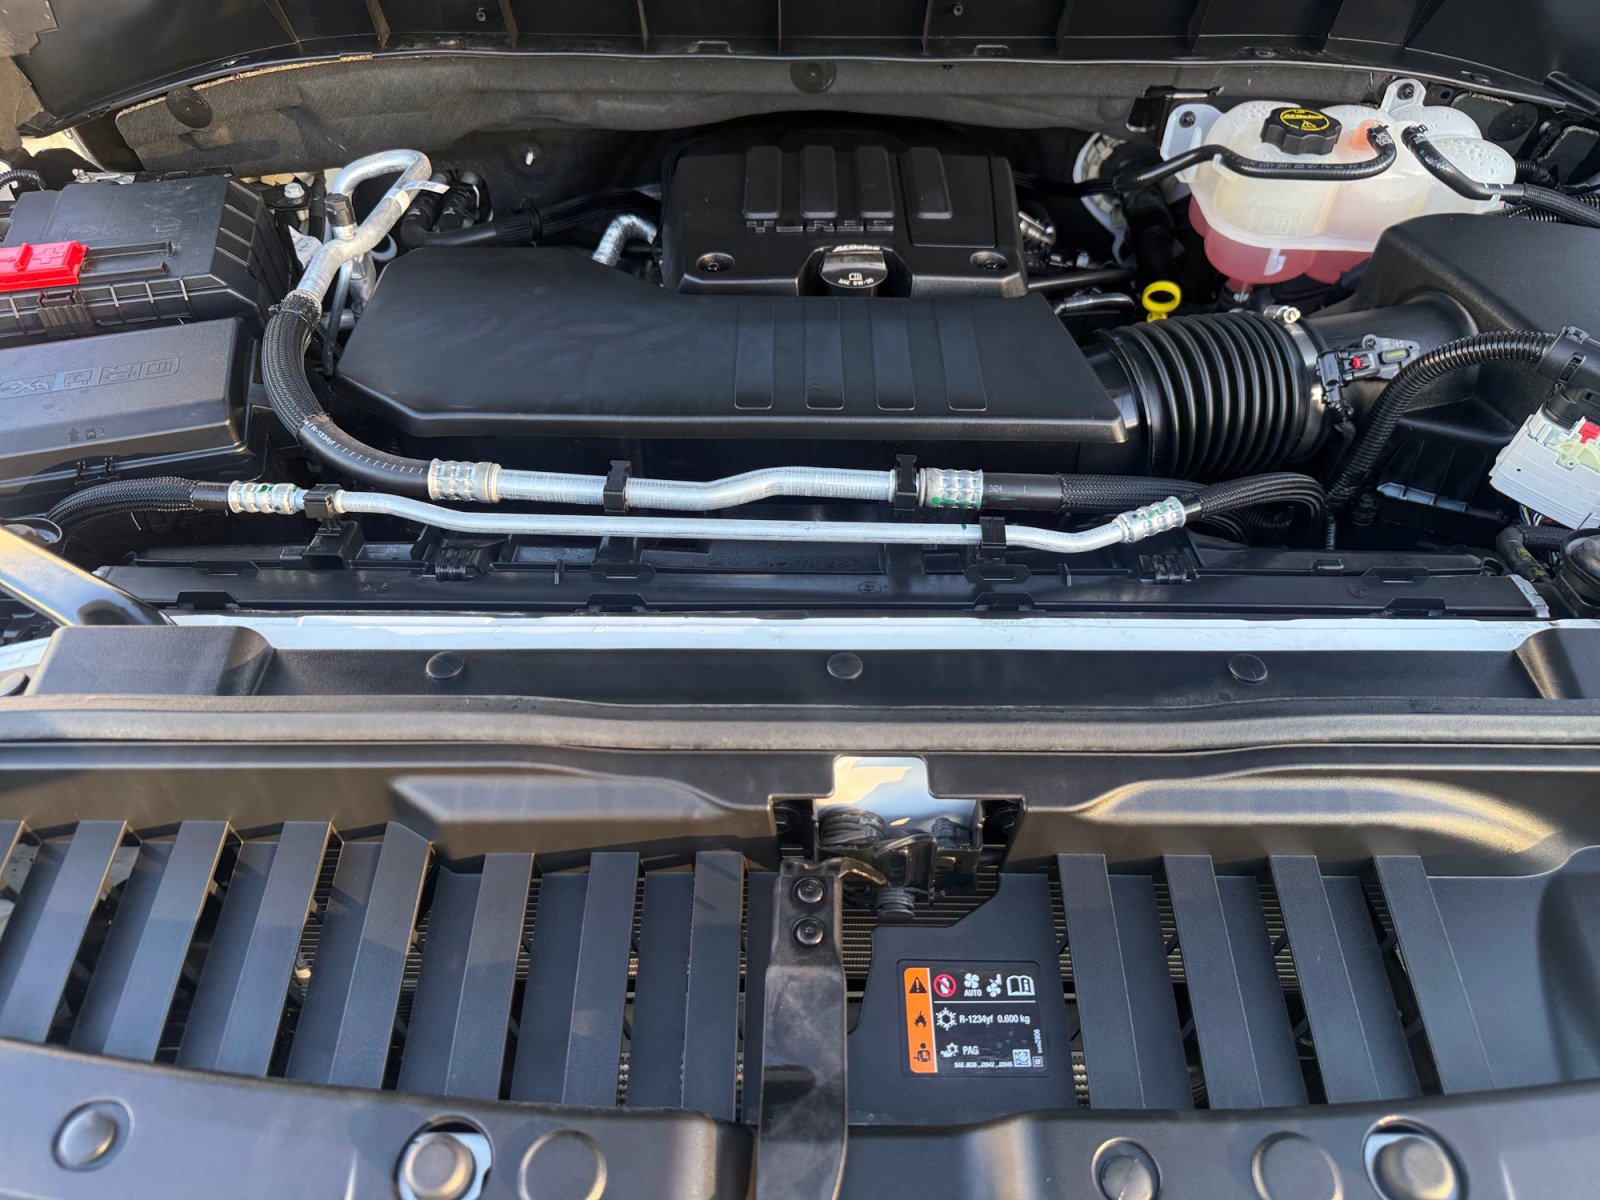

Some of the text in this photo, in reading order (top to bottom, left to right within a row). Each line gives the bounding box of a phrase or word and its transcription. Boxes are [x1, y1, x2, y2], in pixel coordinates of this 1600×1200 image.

[964, 989, 982, 997] AUTO
[959, 1014, 1030, 1025] R-1234yf 0.600 kg
[962, 1045, 979, 1055] PAG
